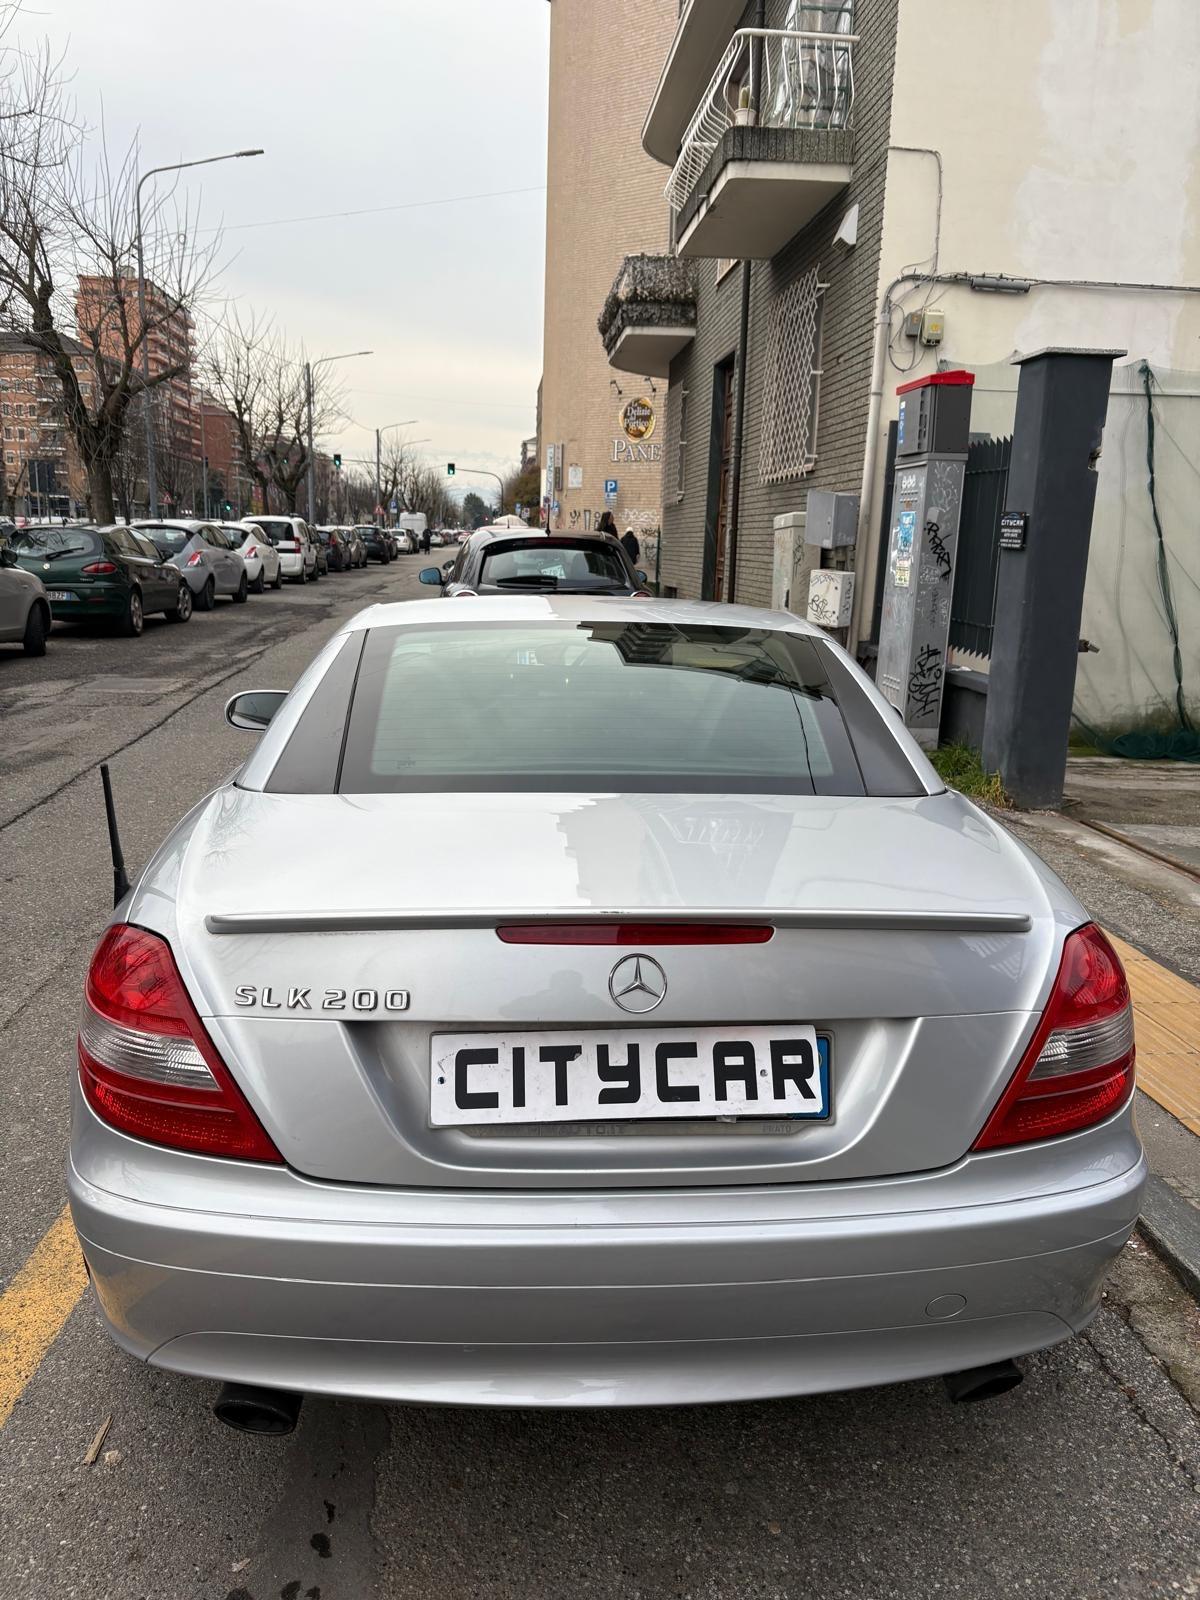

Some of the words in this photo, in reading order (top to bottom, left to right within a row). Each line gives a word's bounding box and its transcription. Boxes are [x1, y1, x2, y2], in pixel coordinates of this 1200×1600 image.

[627, 407, 651, 416] Delizie
[624, 419, 649, 428] Portico
[611, 440, 661, 462] PANE
[607, 482, 615, 492] P
[235, 986, 312, 1009] SLK
[322, 989, 410, 1011] 200
[455, 1039, 816, 1109] CITYCAR
